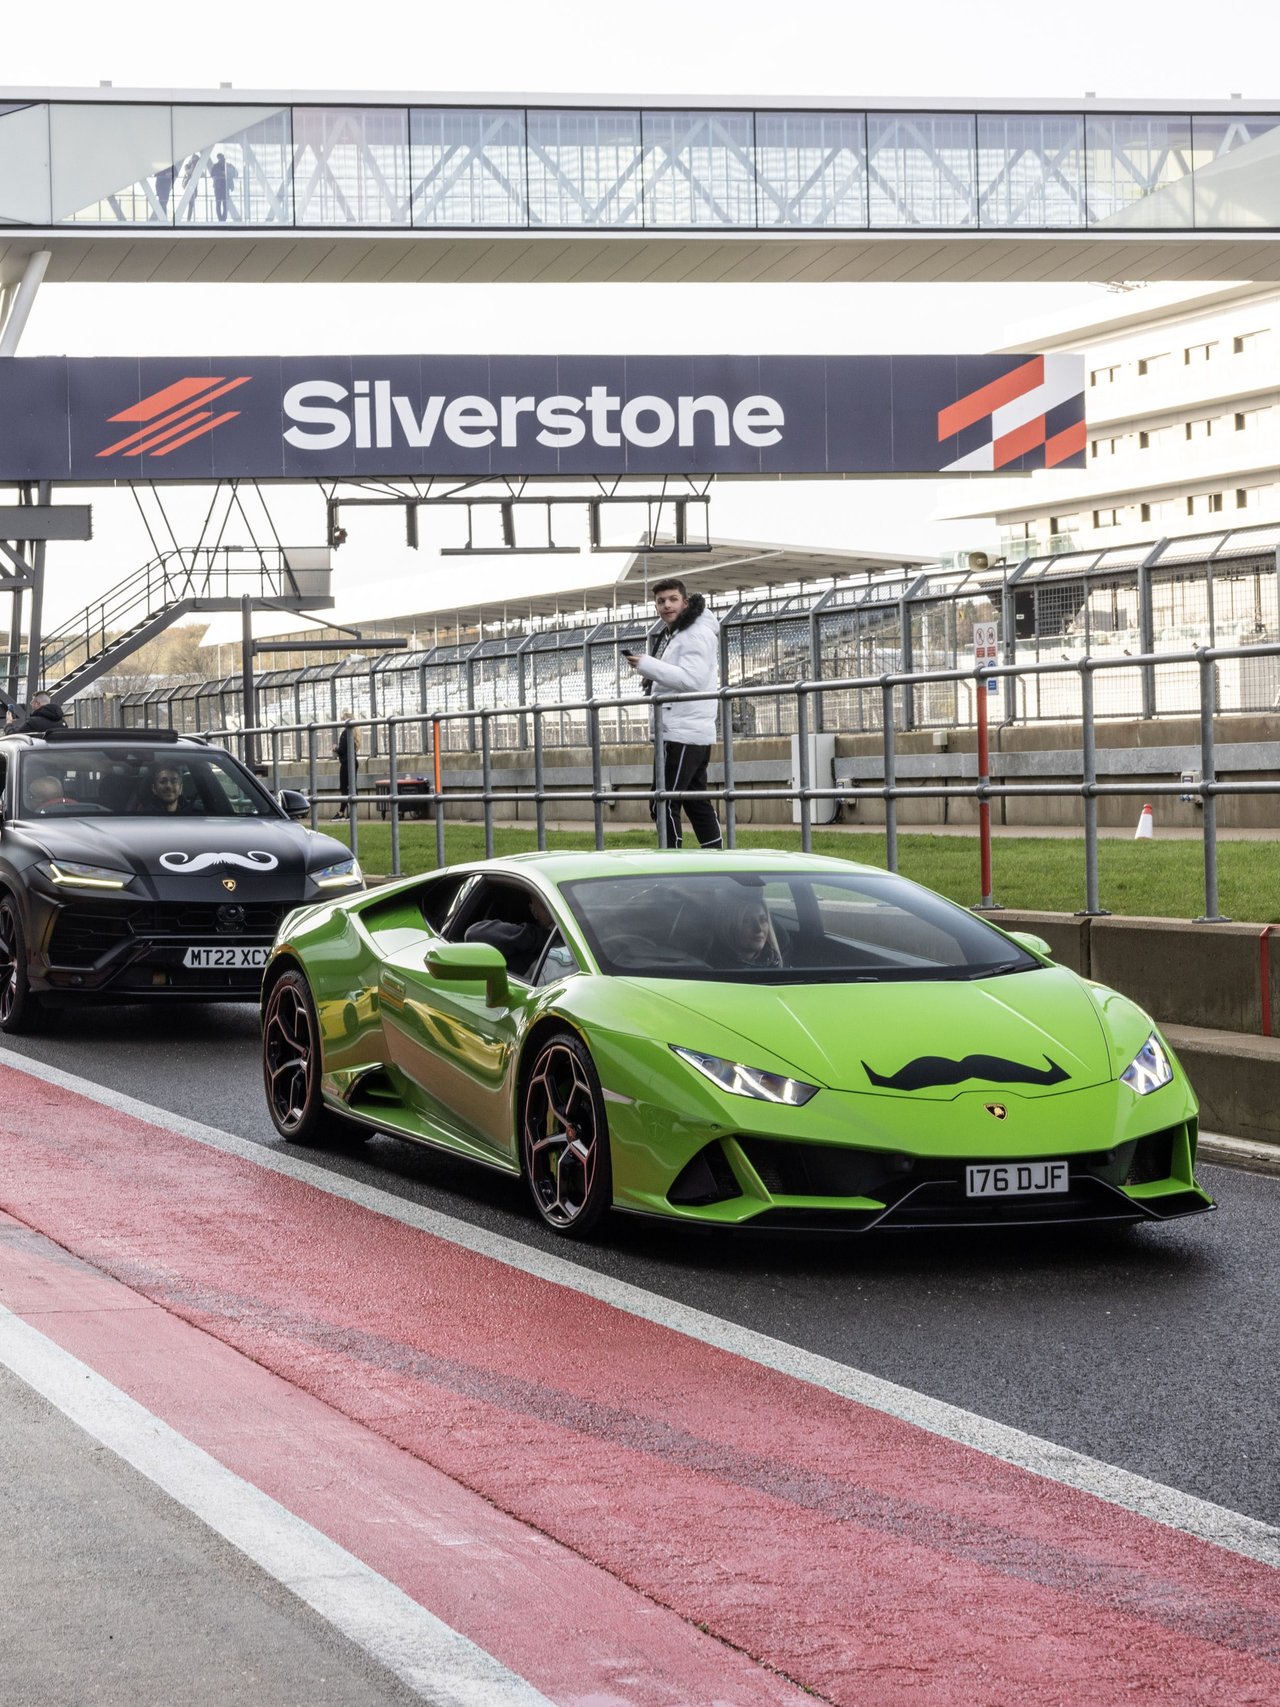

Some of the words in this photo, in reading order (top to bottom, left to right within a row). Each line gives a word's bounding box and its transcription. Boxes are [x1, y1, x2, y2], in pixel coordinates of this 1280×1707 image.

[283, 380, 785, 450] Silverstone
[190, 949, 236, 966] MT22
[969, 1168, 1009, 1193] 176
[1017, 1165, 1065, 1190] DJF
